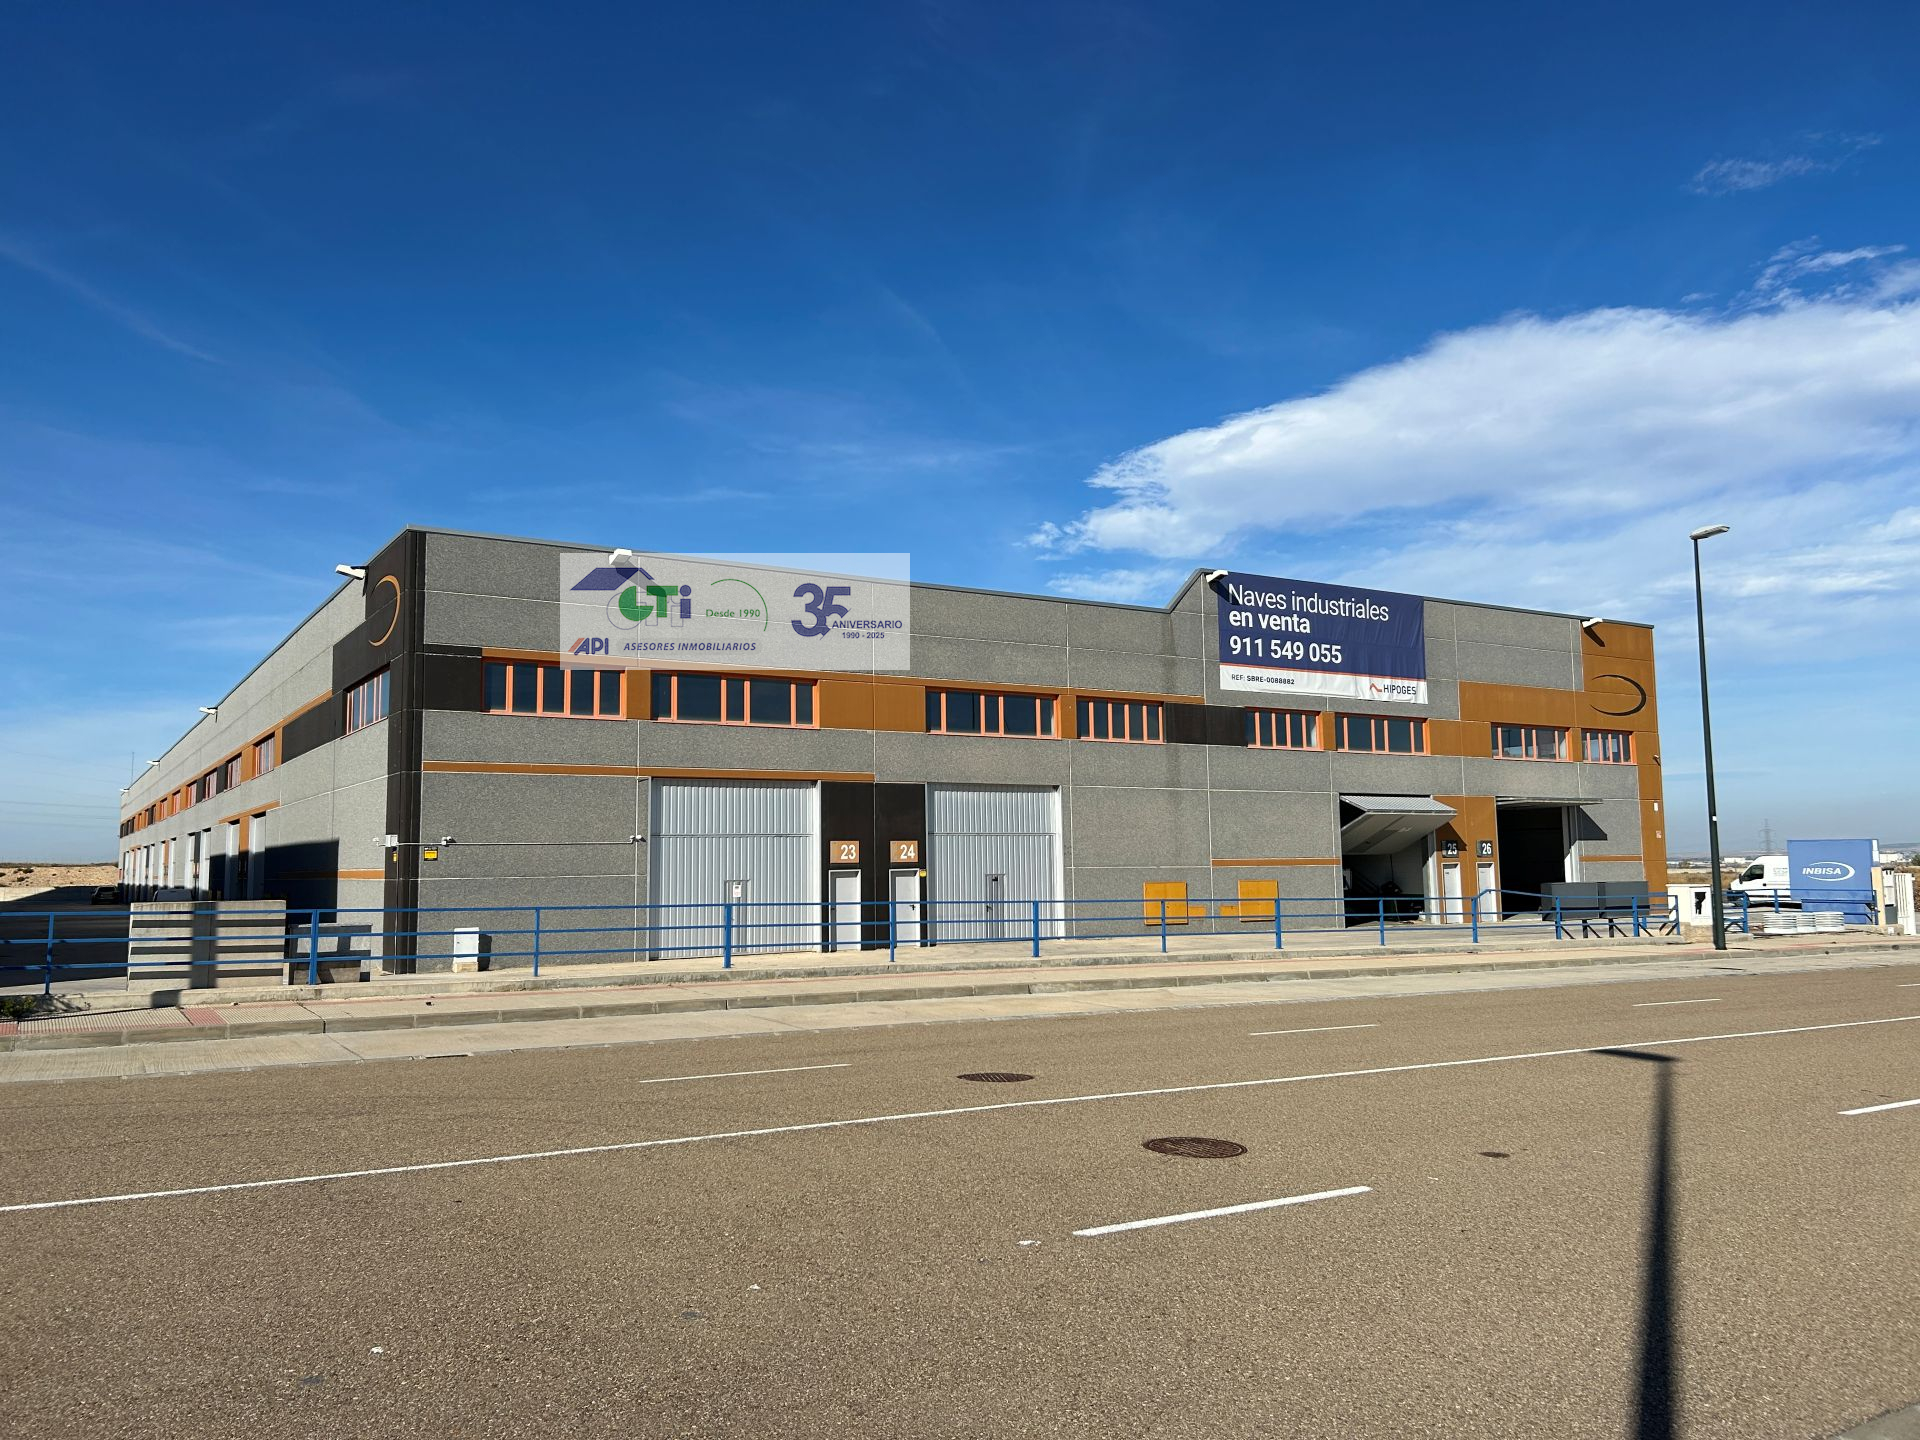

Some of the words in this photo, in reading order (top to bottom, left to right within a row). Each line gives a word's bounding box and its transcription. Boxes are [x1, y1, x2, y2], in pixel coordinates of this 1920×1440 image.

[1228, 583, 1287, 610] Naves
[1291, 590, 1389, 622] industriales
[1228, 610, 1253, 628] en
[1258, 613, 1311, 634] venta
[1229, 635, 1263, 657] 911
[1270, 639, 1304, 661] 549
[1309, 643, 1342, 664] 055
[1231, 673, 1246, 681] REF:
[1383, 684, 1417, 695] HIPOGES
[840, 844, 857, 860] 23
[900, 844, 916, 859] 24
[1447, 843, 1458, 855] 25
[1481, 842, 1492, 855] 26
[1802, 867, 1842, 875] INBISA
